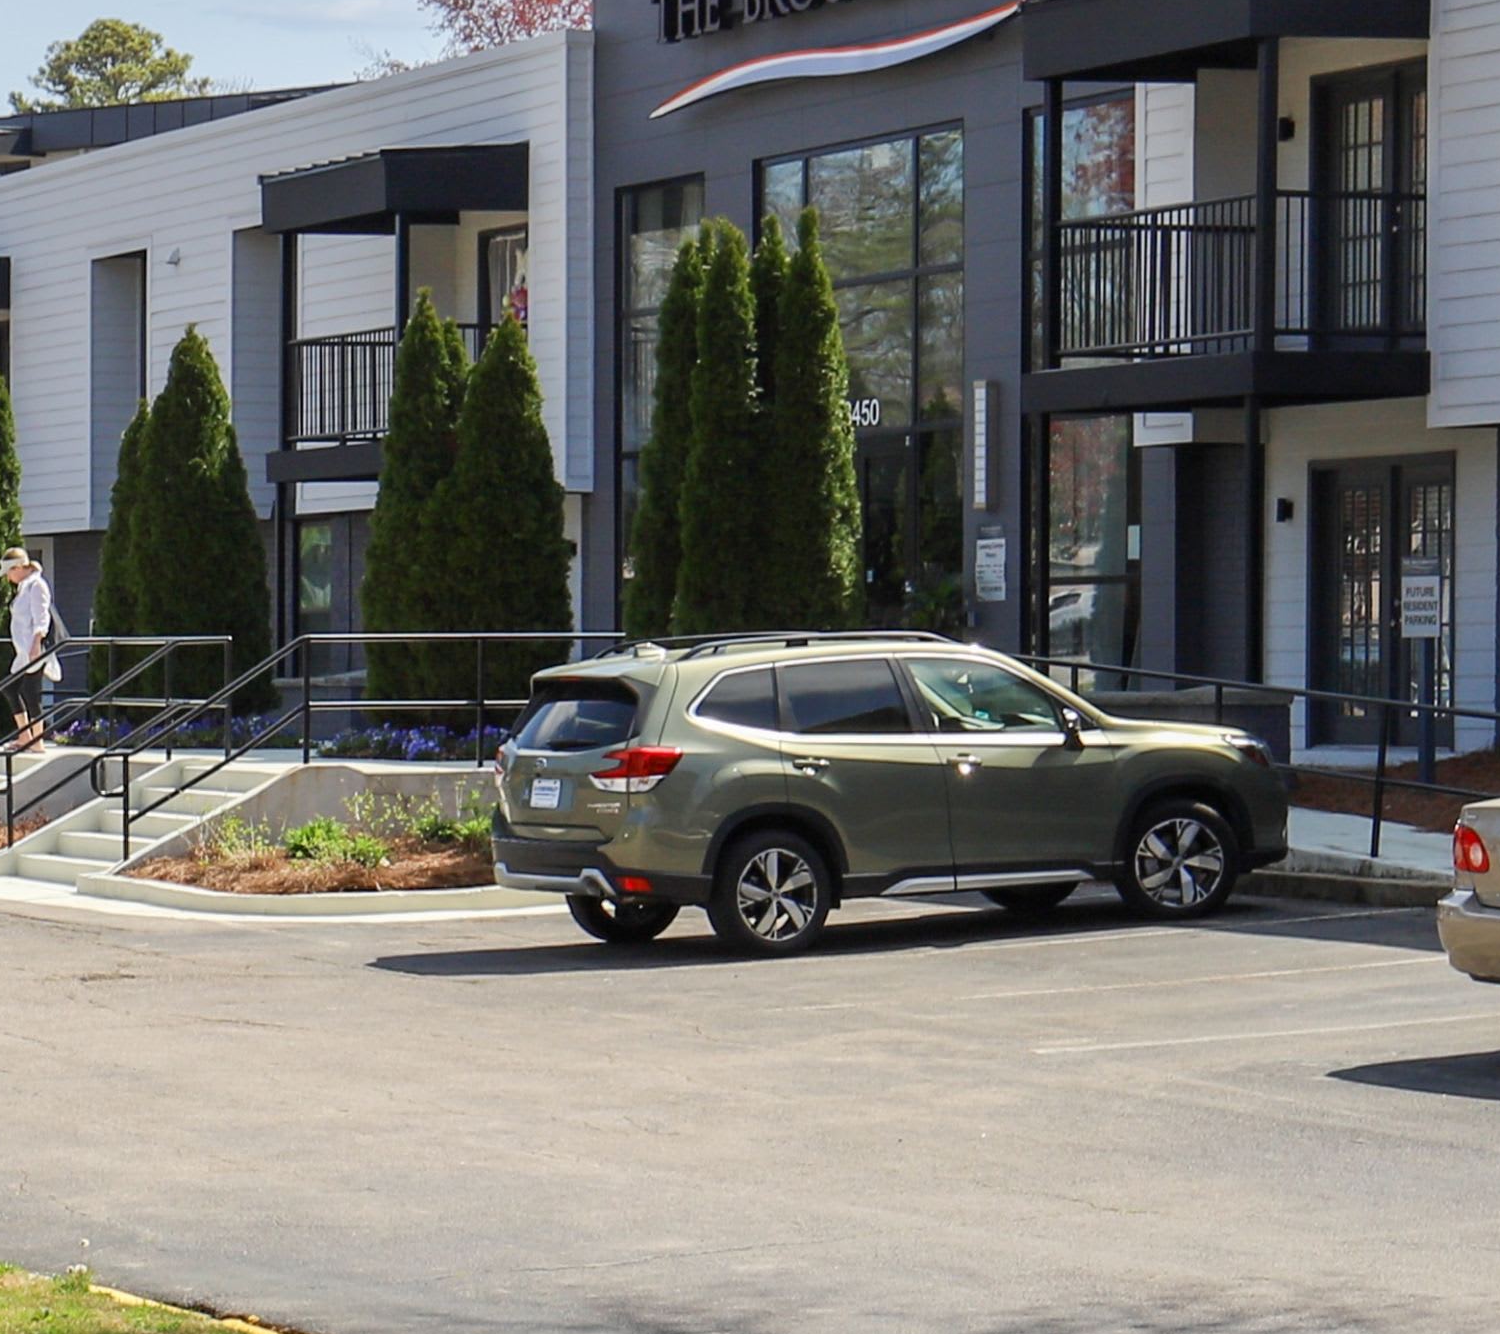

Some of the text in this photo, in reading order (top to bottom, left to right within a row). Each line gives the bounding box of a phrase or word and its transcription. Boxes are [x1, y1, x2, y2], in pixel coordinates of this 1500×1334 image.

[1405, 586, 1435, 598] FUTURE
[1402, 600, 1439, 612] RESIDENT
[1404, 614, 1438, 626] PARKING
